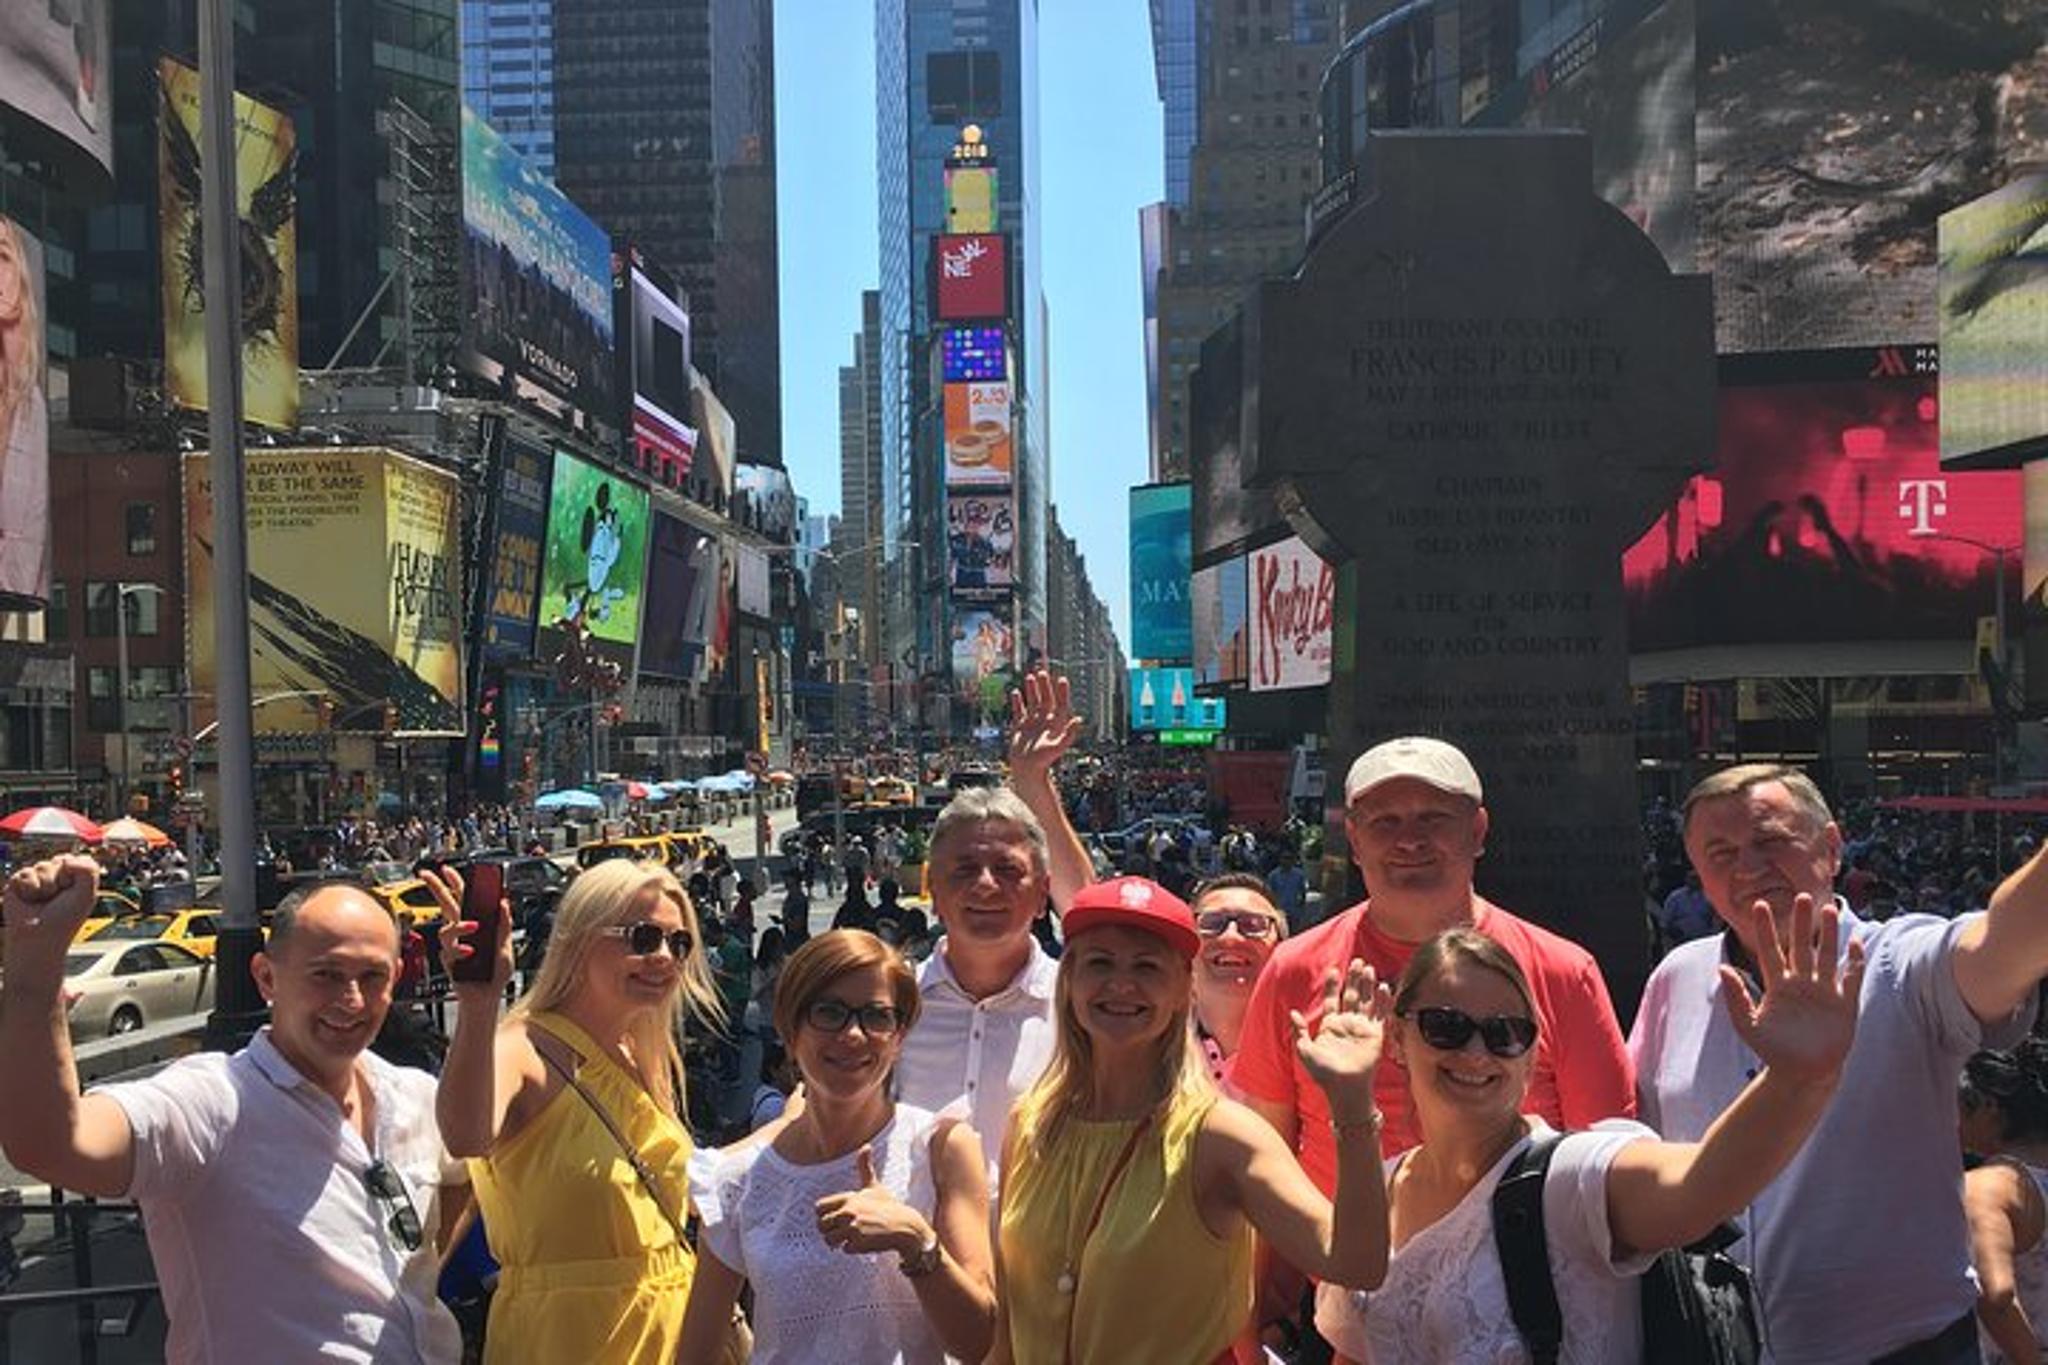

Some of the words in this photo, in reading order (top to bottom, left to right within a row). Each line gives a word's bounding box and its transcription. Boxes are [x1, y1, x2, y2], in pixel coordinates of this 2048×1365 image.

[519, 337, 578, 388] VORNADO
[1350, 346, 1480, 377] FRANCIS
[1521, 345, 1627, 374] DUFFY
[315, 459, 355, 473] WILL
[258, 477, 278, 492] BE
[284, 476, 315, 491] THE
[320, 474, 365, 490] SAME
[393, 541, 451, 588] HARRY
[394, 574, 452, 618] POTTER
[1414, 593, 1459, 611] LIFE
[1505, 592, 1592, 611] SERVICE
[1382, 637, 1434, 656] GOD
[1442, 636, 1490, 656] AND
[1496, 636, 1604, 655] COUNTRY
